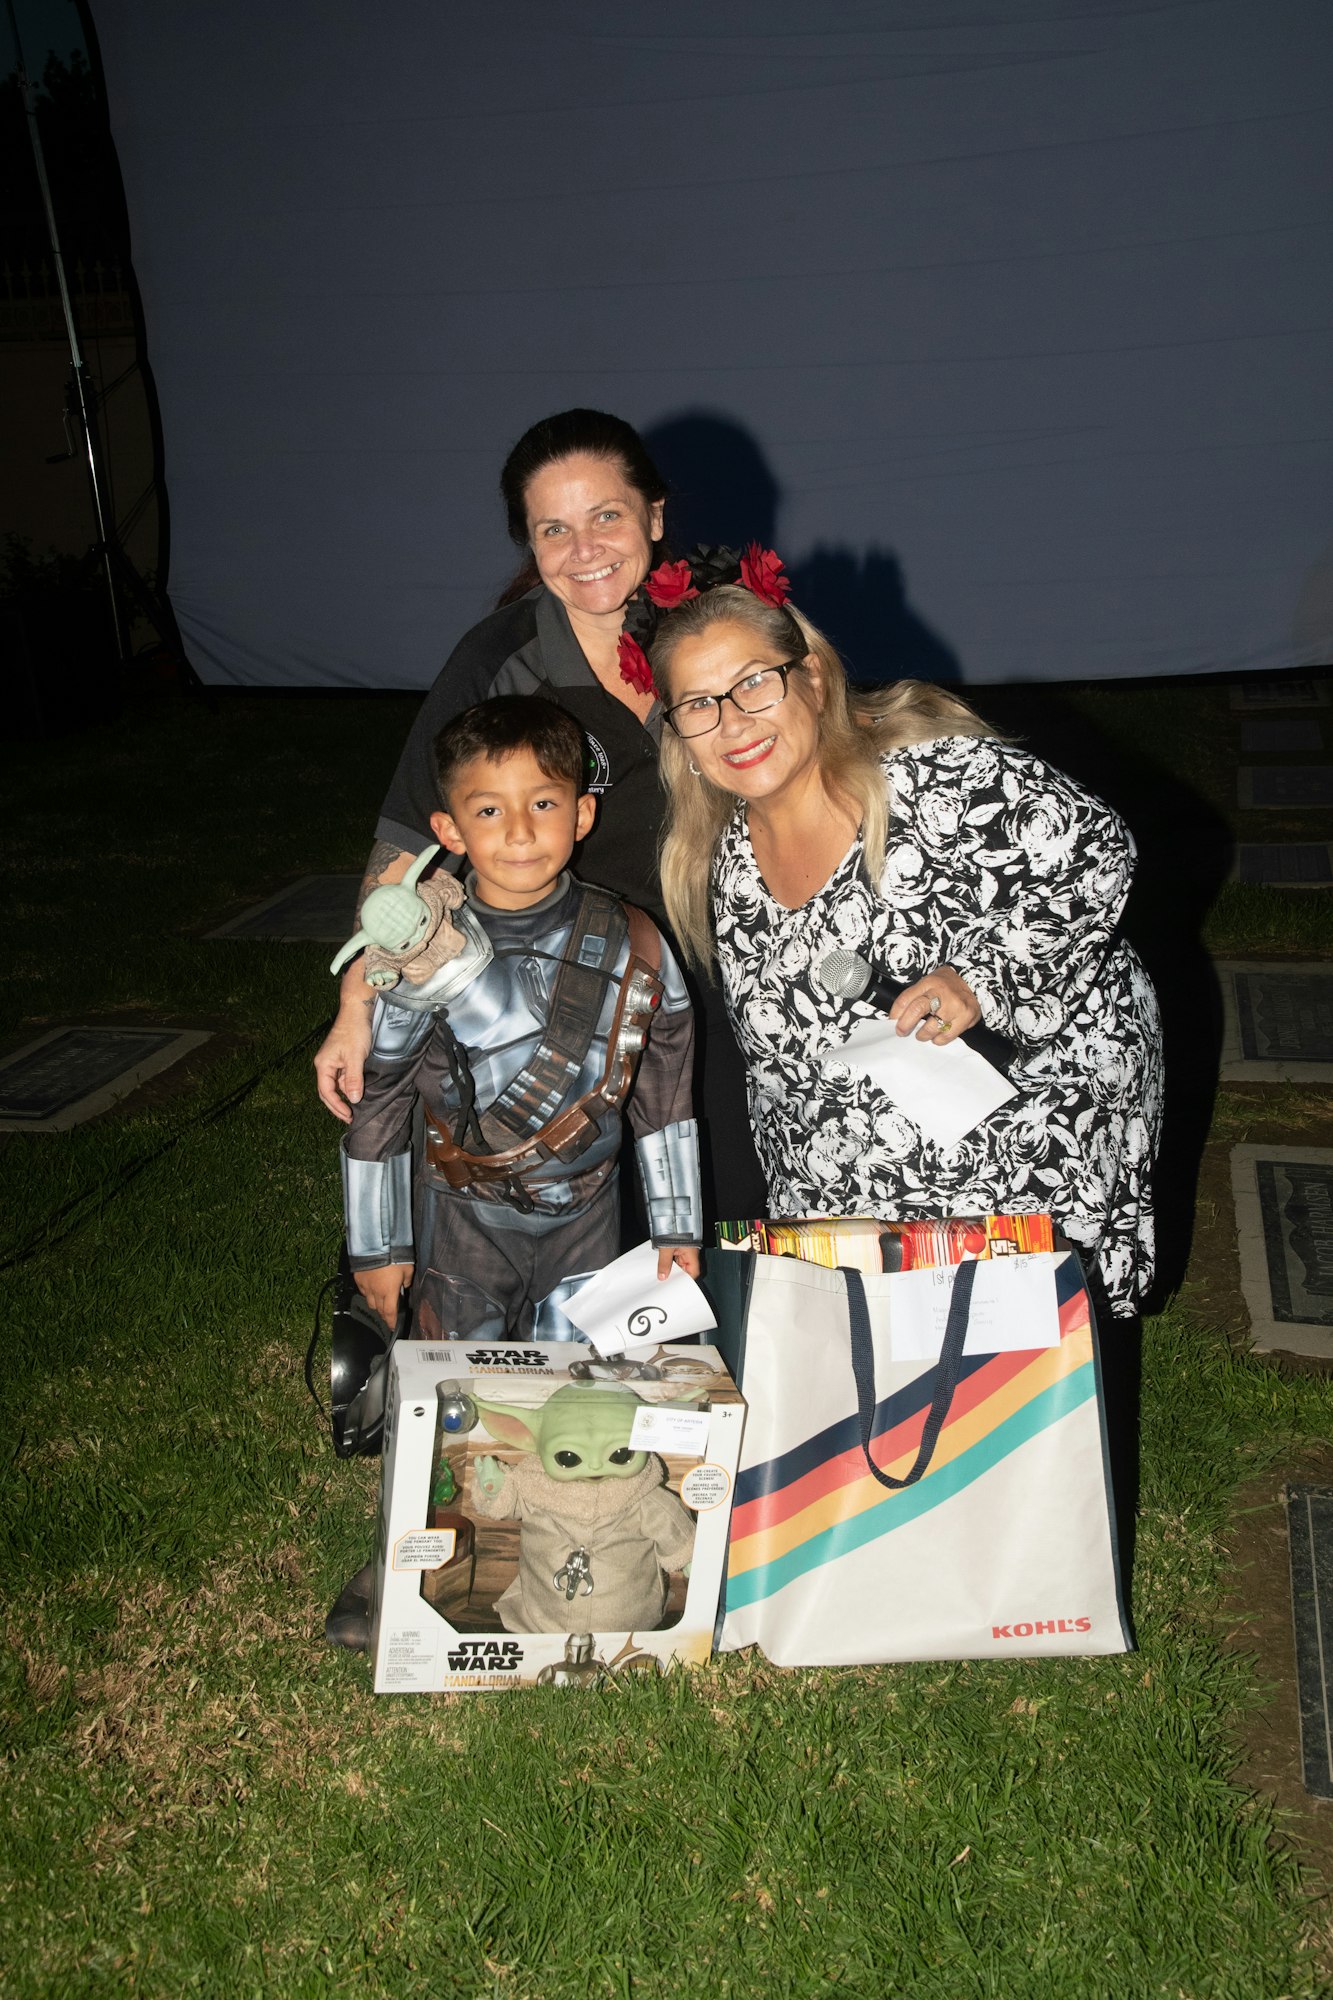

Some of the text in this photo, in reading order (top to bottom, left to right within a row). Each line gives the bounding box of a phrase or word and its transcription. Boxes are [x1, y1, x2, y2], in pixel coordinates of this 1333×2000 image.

[465, 1349, 549, 1358] STAR
[466, 1357, 550, 1366] WARS
[468, 1366, 555, 1375] MANDALORIAN
[991, 1616, 1091, 1638] KOHL'S
[447, 1641, 524, 1656] STAR
[447, 1656, 524, 1671] WARS
[444, 1674, 521, 1687] MANDALORIAN
